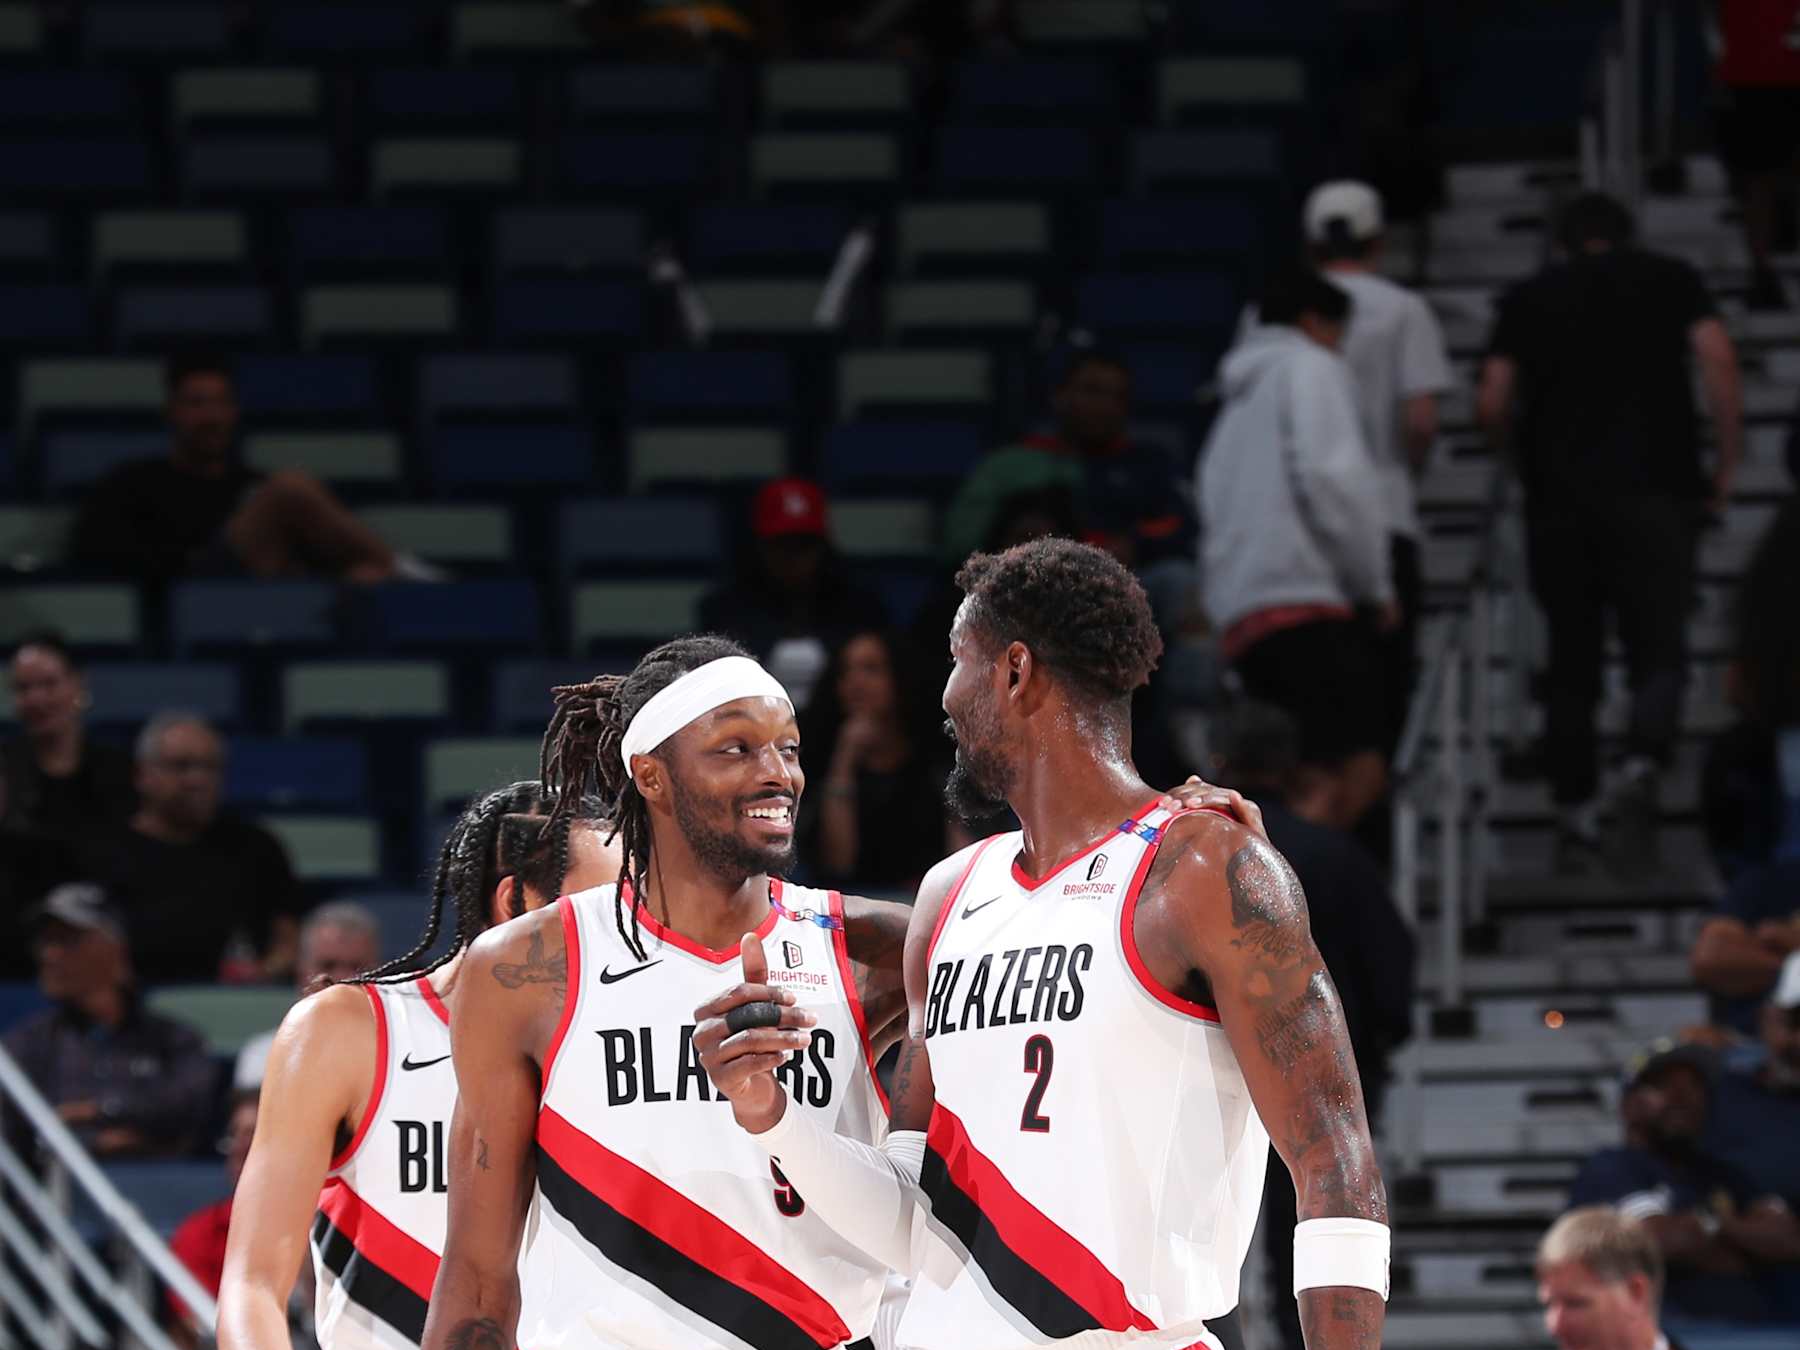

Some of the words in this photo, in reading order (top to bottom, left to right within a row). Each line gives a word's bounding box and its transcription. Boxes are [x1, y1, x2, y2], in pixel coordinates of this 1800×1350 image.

[1063, 882, 1117, 896] BRIGHTSIDE
[770, 970, 828, 985] RIGHTSIDE
[925, 942, 1094, 1040] BLAZERS
[594, 1024, 835, 1109] BLARS
[1020, 1033, 1054, 1133] 2
